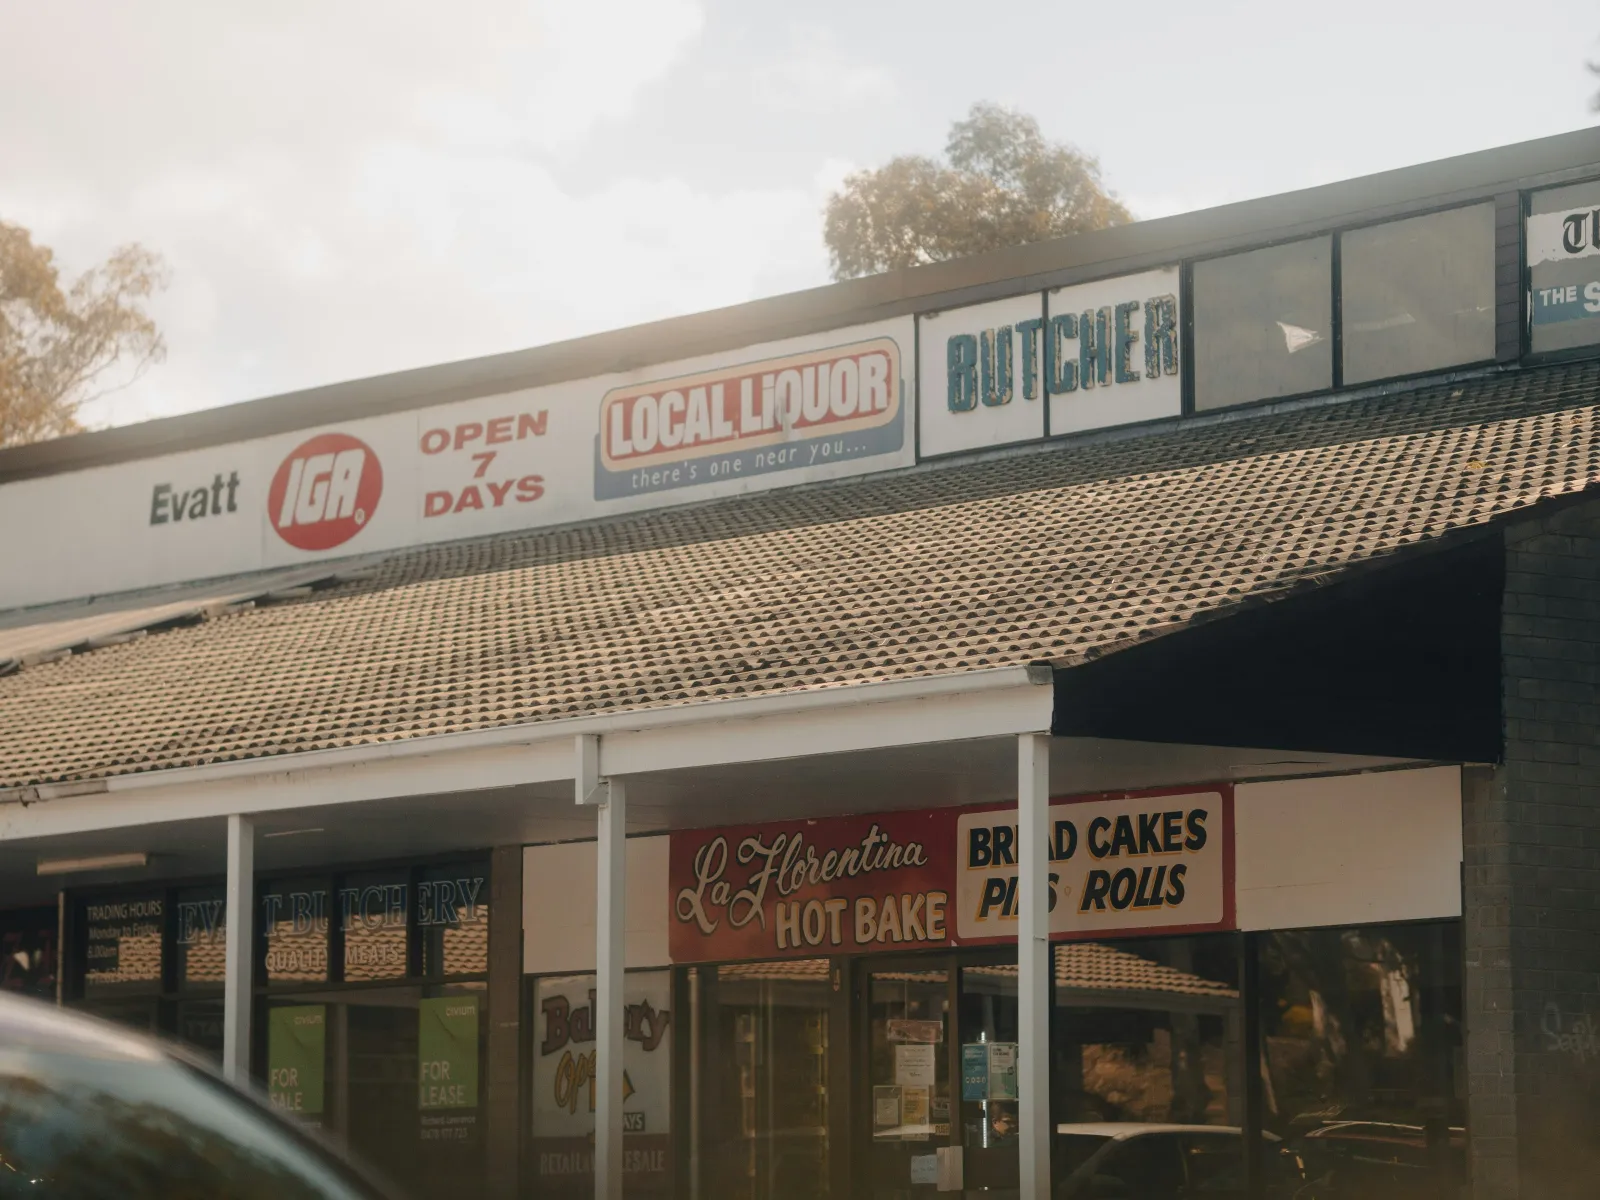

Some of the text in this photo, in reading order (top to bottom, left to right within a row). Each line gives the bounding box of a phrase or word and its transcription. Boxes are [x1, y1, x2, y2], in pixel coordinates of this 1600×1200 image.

[1539, 285, 1578, 307] THE
[947, 292, 1179, 414] BUTCHER
[419, 409, 549, 456] OPEN
[610, 383, 733, 457] LOCAL
[471, 451, 498, 478] 7
[632, 459, 698, 490] there's
[710, 458, 742, 476] one
[755, 445, 797, 468] near
[149, 469, 240, 526] Evatt
[423, 474, 546, 518] DAYS
[966, 807, 1209, 870] BRD CAKES
[676, 823, 928, 935] La Florentina
[977, 863, 1188, 923] PIS ROLLS
[86, 900, 162, 921] TRADING HOURS
[774, 890, 949, 950] HOT BAKE
[344, 943, 398, 966] MEATS
[270, 1067, 299, 1088] FOR
[420, 1060, 451, 1081] FOR
[270, 1092, 303, 1111] SALE
[420, 1085, 466, 1107] LEASE
